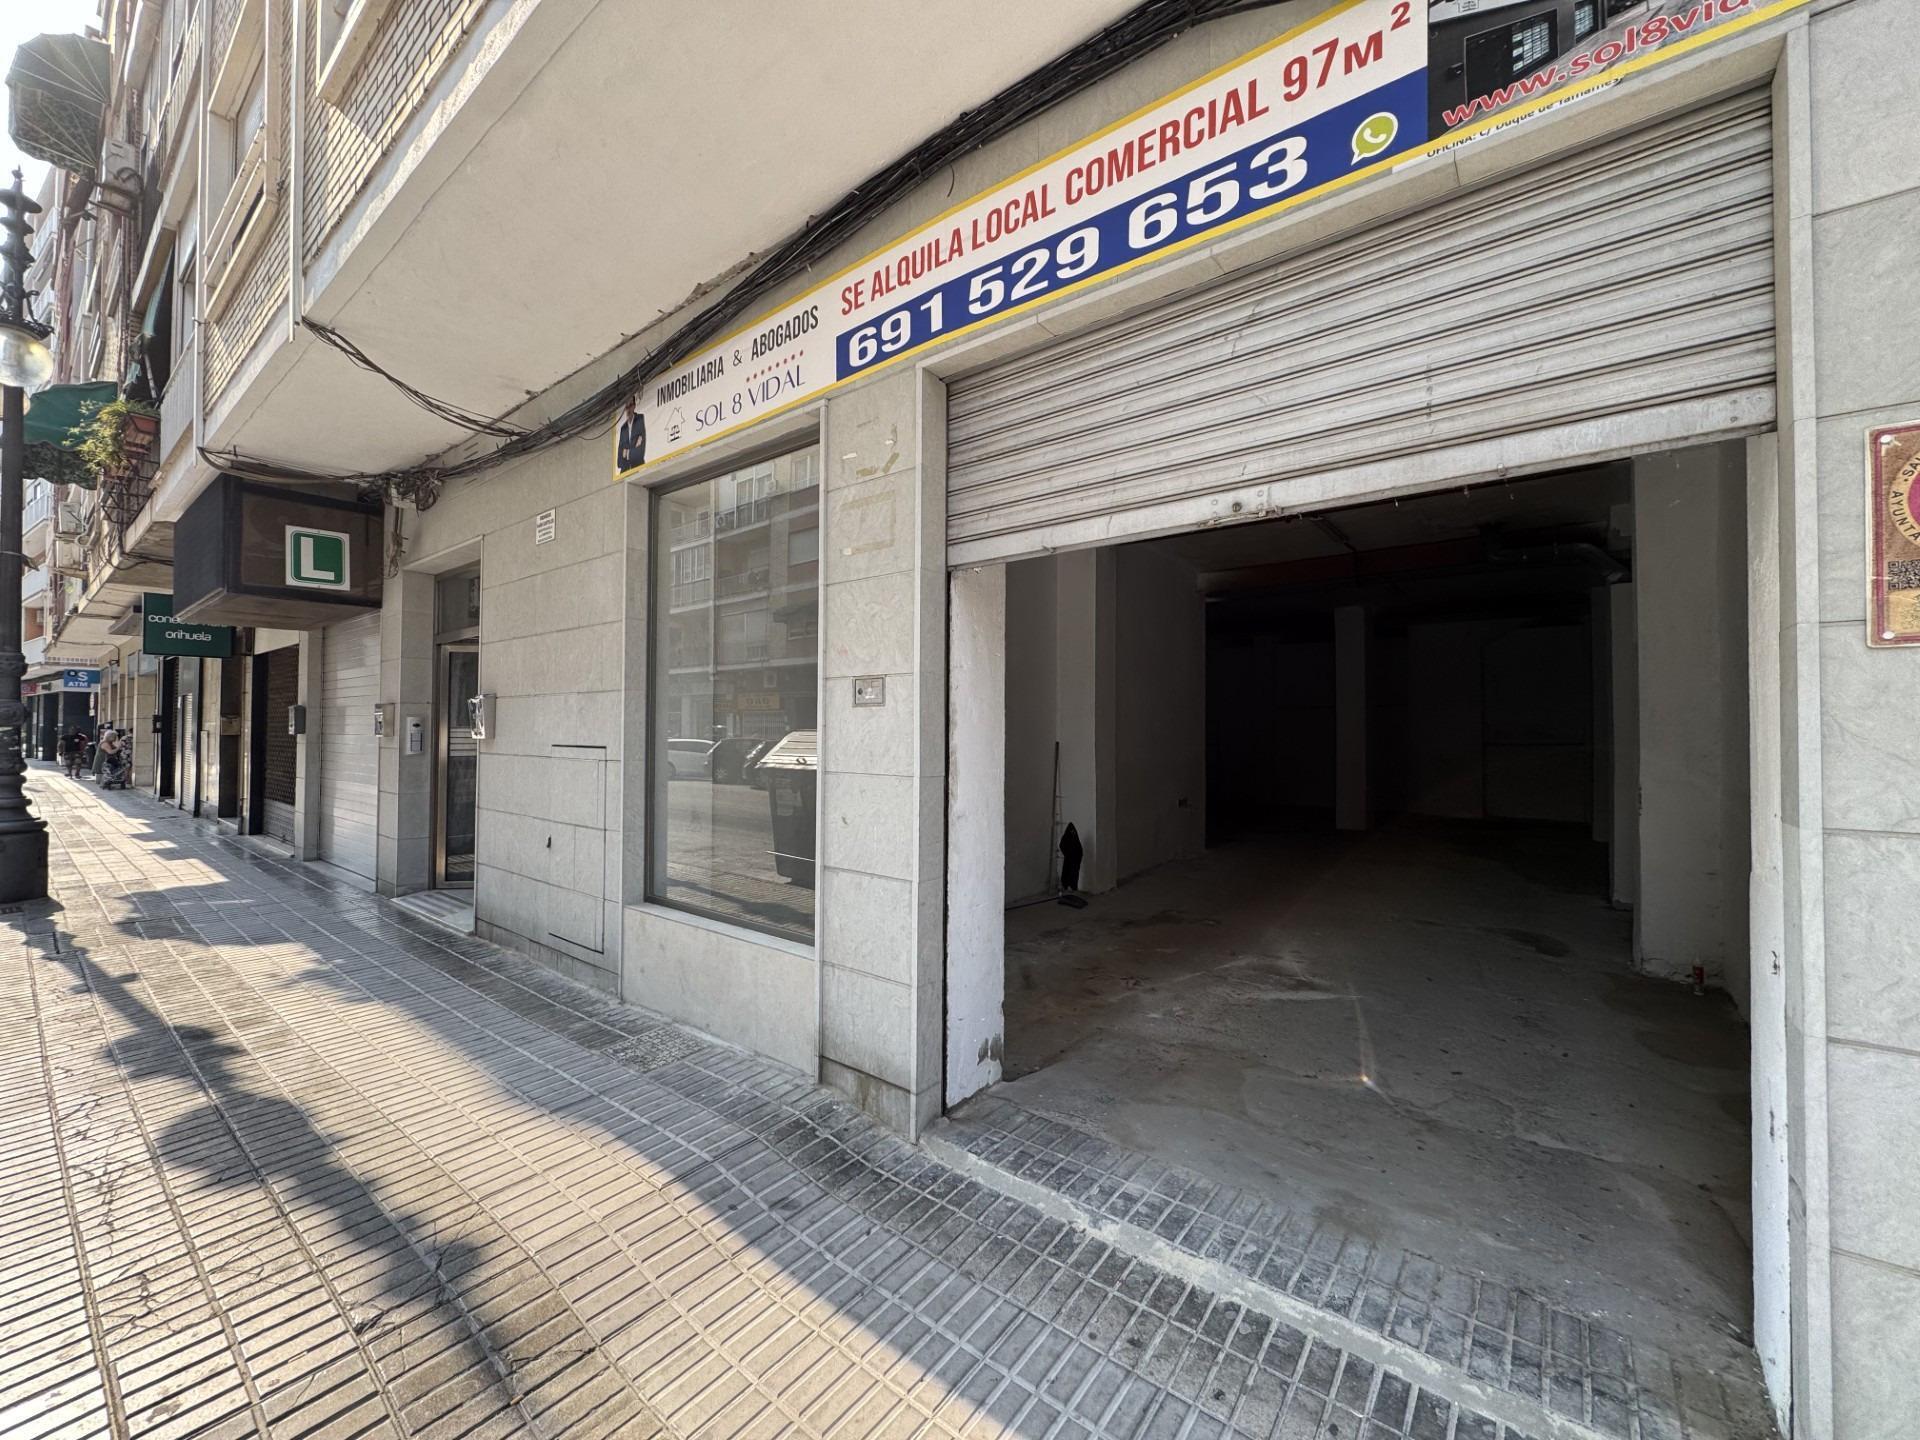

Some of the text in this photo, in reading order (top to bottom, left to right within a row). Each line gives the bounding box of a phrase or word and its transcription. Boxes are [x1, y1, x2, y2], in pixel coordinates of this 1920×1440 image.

[841, 279, 865, 316] SE
[871, 228, 964, 302] ALQUILA
[972, 184, 1056, 250] LOCAL
[1065, 78, 1270, 206] COMERCIAL
[849, 136, 1308, 368] 691 529 653
[656, 305, 819, 408] INMOBILIARIA & ABOGADOS
[696, 365, 806, 431] SOL 8 VIDAL
[301, 536, 335, 581] L
[165, 630, 212, 641] orihuela
